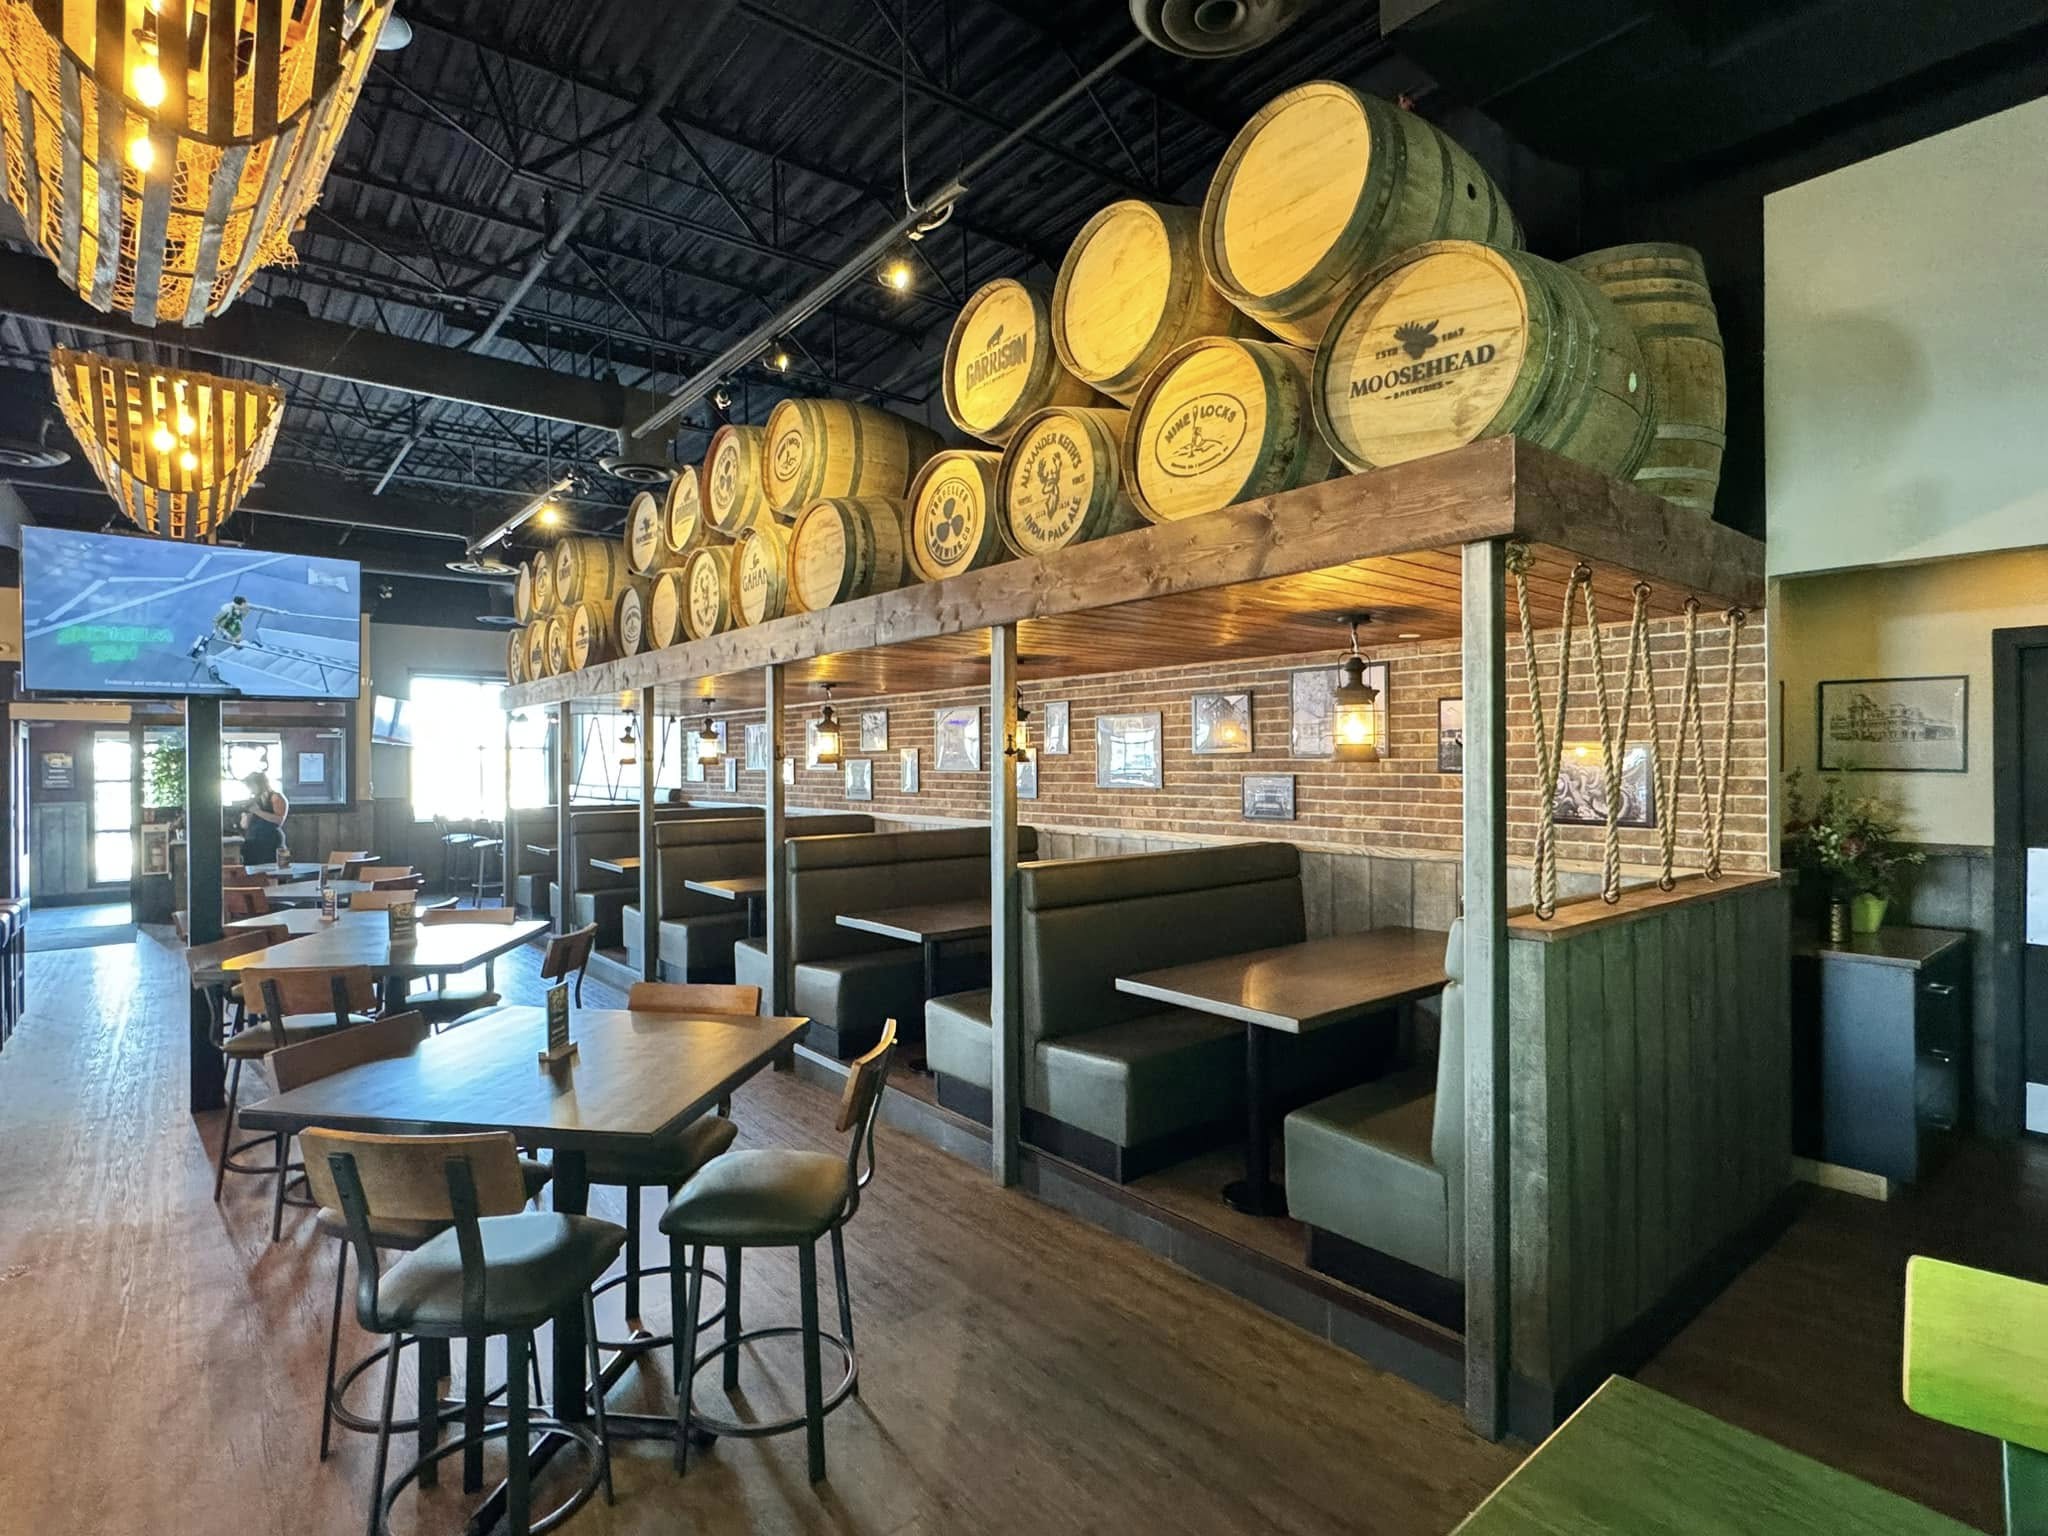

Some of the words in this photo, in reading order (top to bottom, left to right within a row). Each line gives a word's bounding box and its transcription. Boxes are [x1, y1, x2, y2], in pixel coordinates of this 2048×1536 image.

[966, 331, 1028, 392] GARRISON
[1350, 344, 1496, 399] MOOSEHEAD
[1393, 380, 1443, 400] BREWERIES
[1164, 412, 1191, 444] NINE
[1200, 404, 1237, 423] LOCKS
[1020, 432, 1057, 489] ALEXANDER
[1057, 433, 1082, 470] KEITH'S
[930, 485, 969, 516] PROPELLER
[1024, 513, 1045, 541] INDIA
[1047, 520, 1070, 542] PALE
[1067, 495, 1082, 523] ALE
[743, 567, 768, 593] GAHAN
